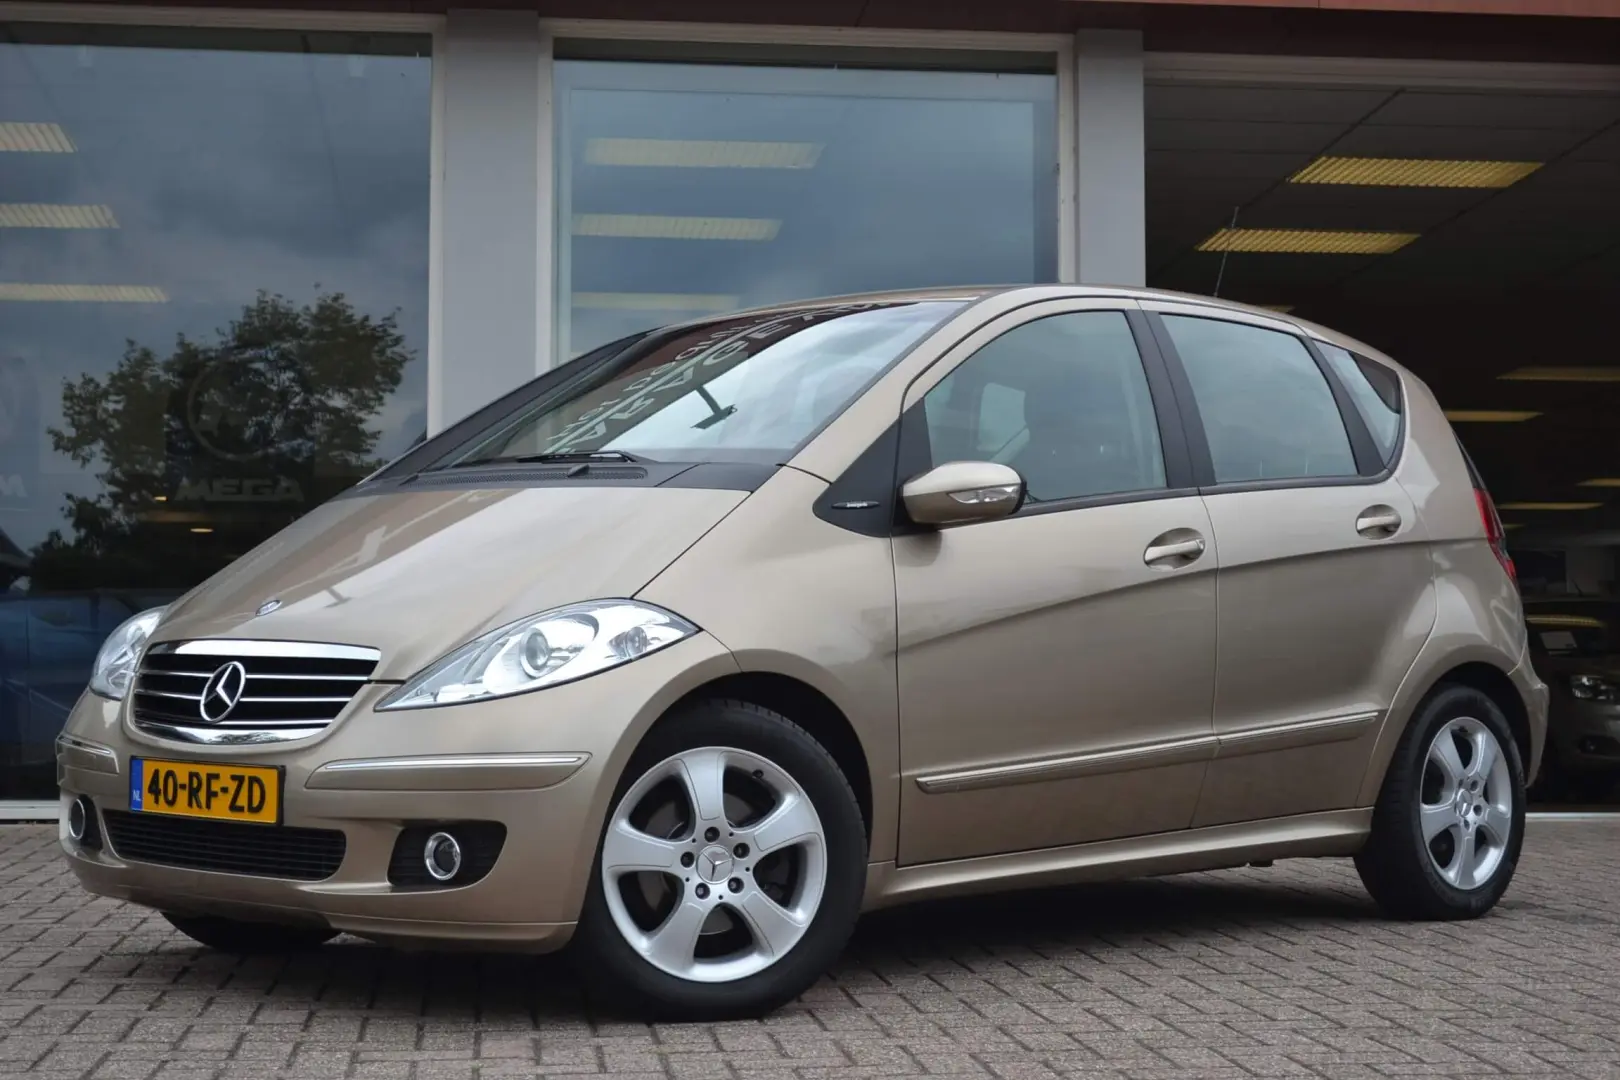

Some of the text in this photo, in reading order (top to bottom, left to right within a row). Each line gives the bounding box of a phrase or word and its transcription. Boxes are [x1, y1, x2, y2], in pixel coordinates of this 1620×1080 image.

[174, 476, 305, 502] MEGA
[132, 790, 142, 802] NL
[147, 768, 267, 814] 40-RF-ZD
